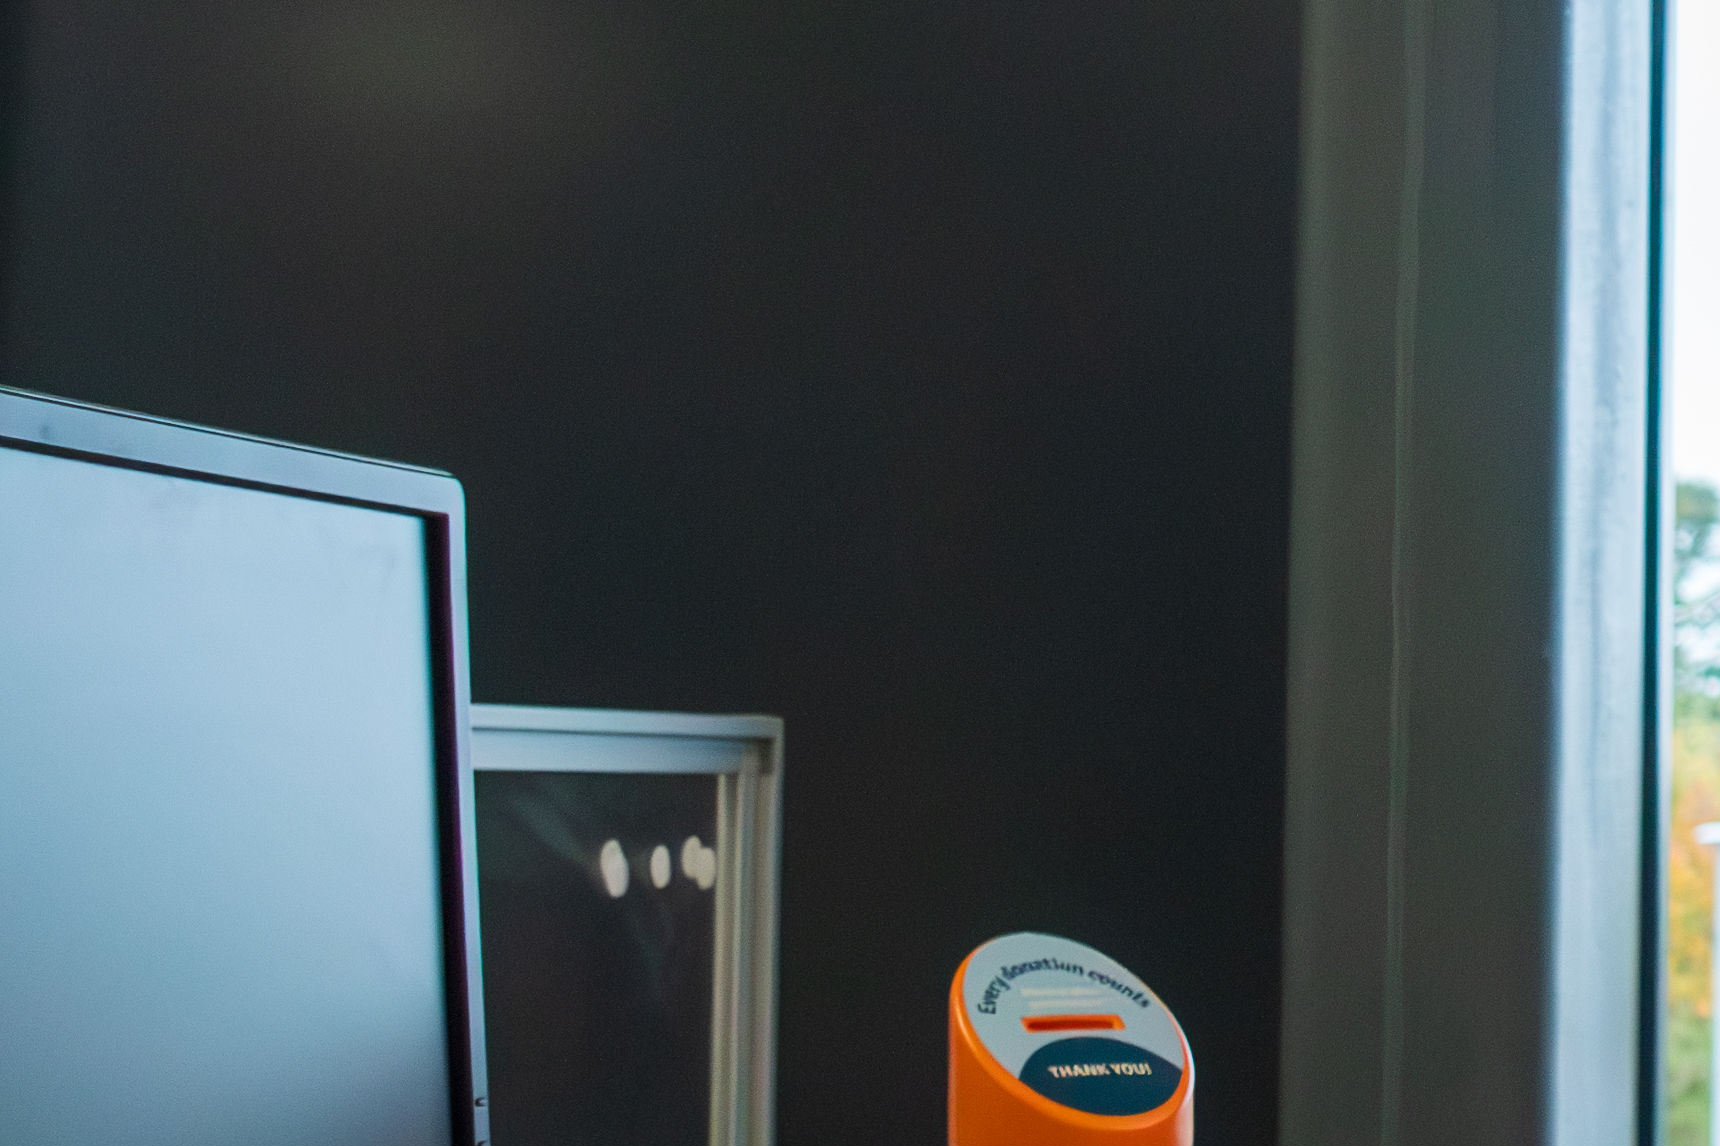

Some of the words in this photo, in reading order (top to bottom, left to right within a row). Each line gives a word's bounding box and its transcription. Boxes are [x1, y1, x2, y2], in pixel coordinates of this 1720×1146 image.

[978, 976, 1010, 1015] Every
[1001, 957, 1084, 981] donation
[1047, 1063, 1110, 1079] THANK
